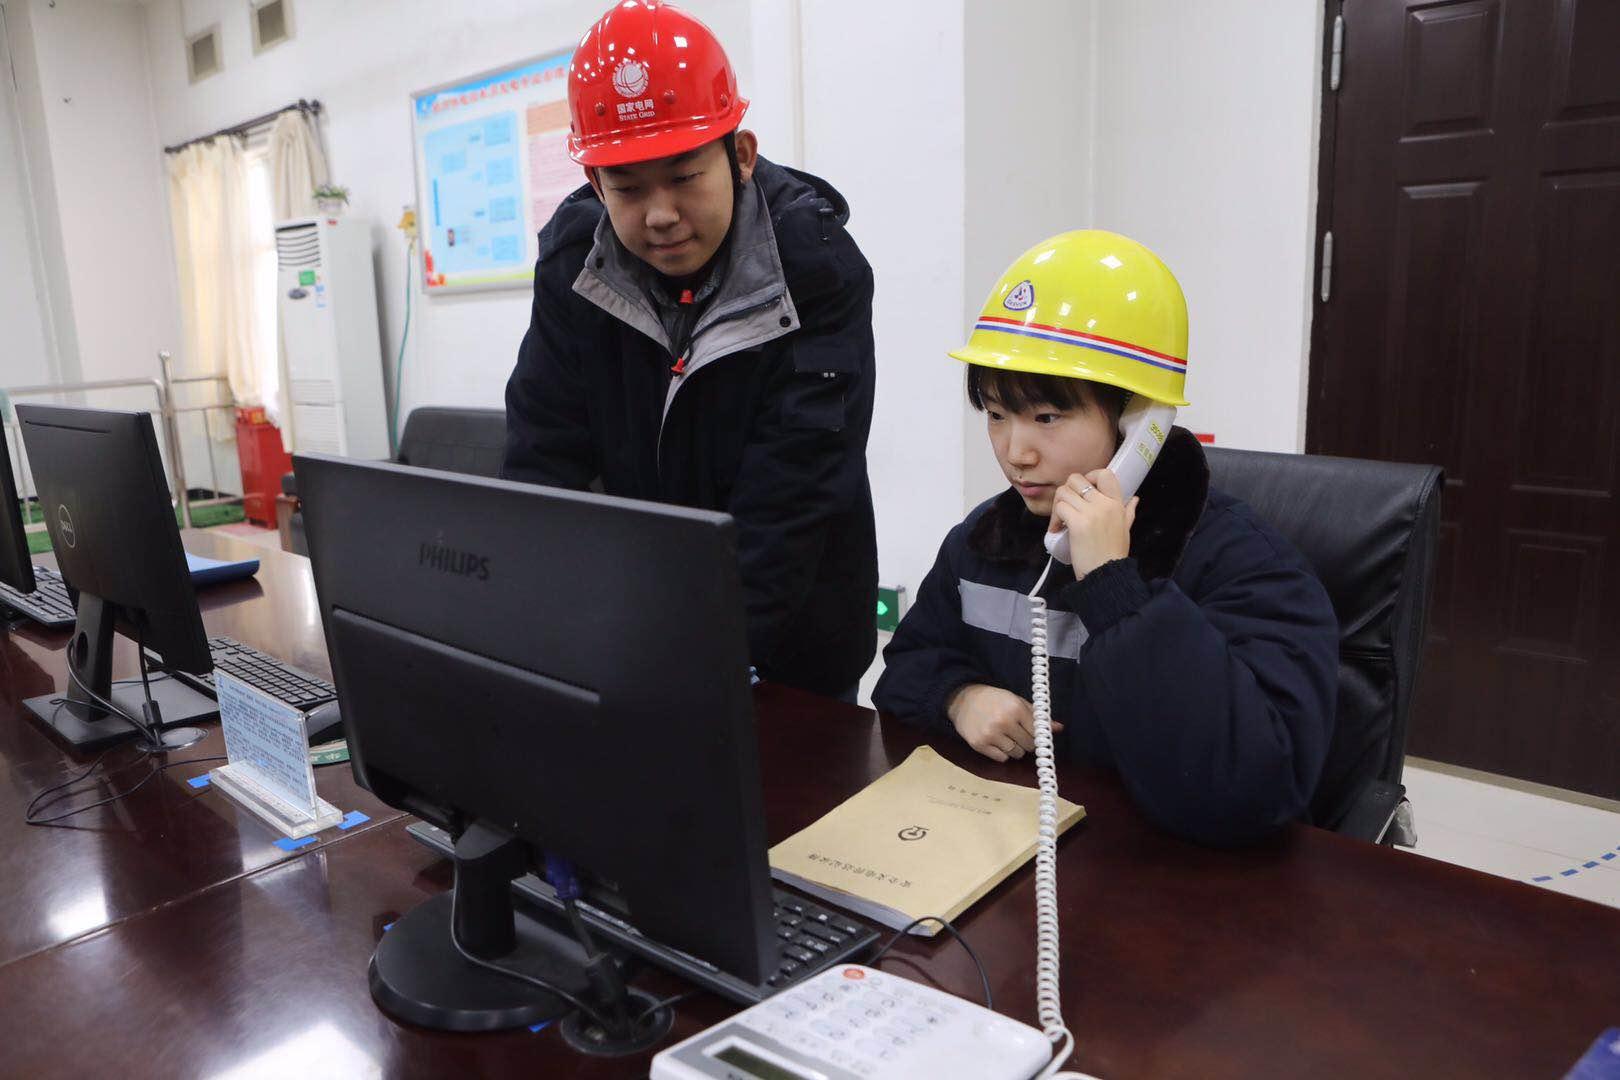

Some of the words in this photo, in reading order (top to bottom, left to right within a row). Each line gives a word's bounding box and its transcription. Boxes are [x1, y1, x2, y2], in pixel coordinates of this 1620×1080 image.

[616, 99, 654, 114] 国家电网
[419, 543, 490, 581] PHILIPS
